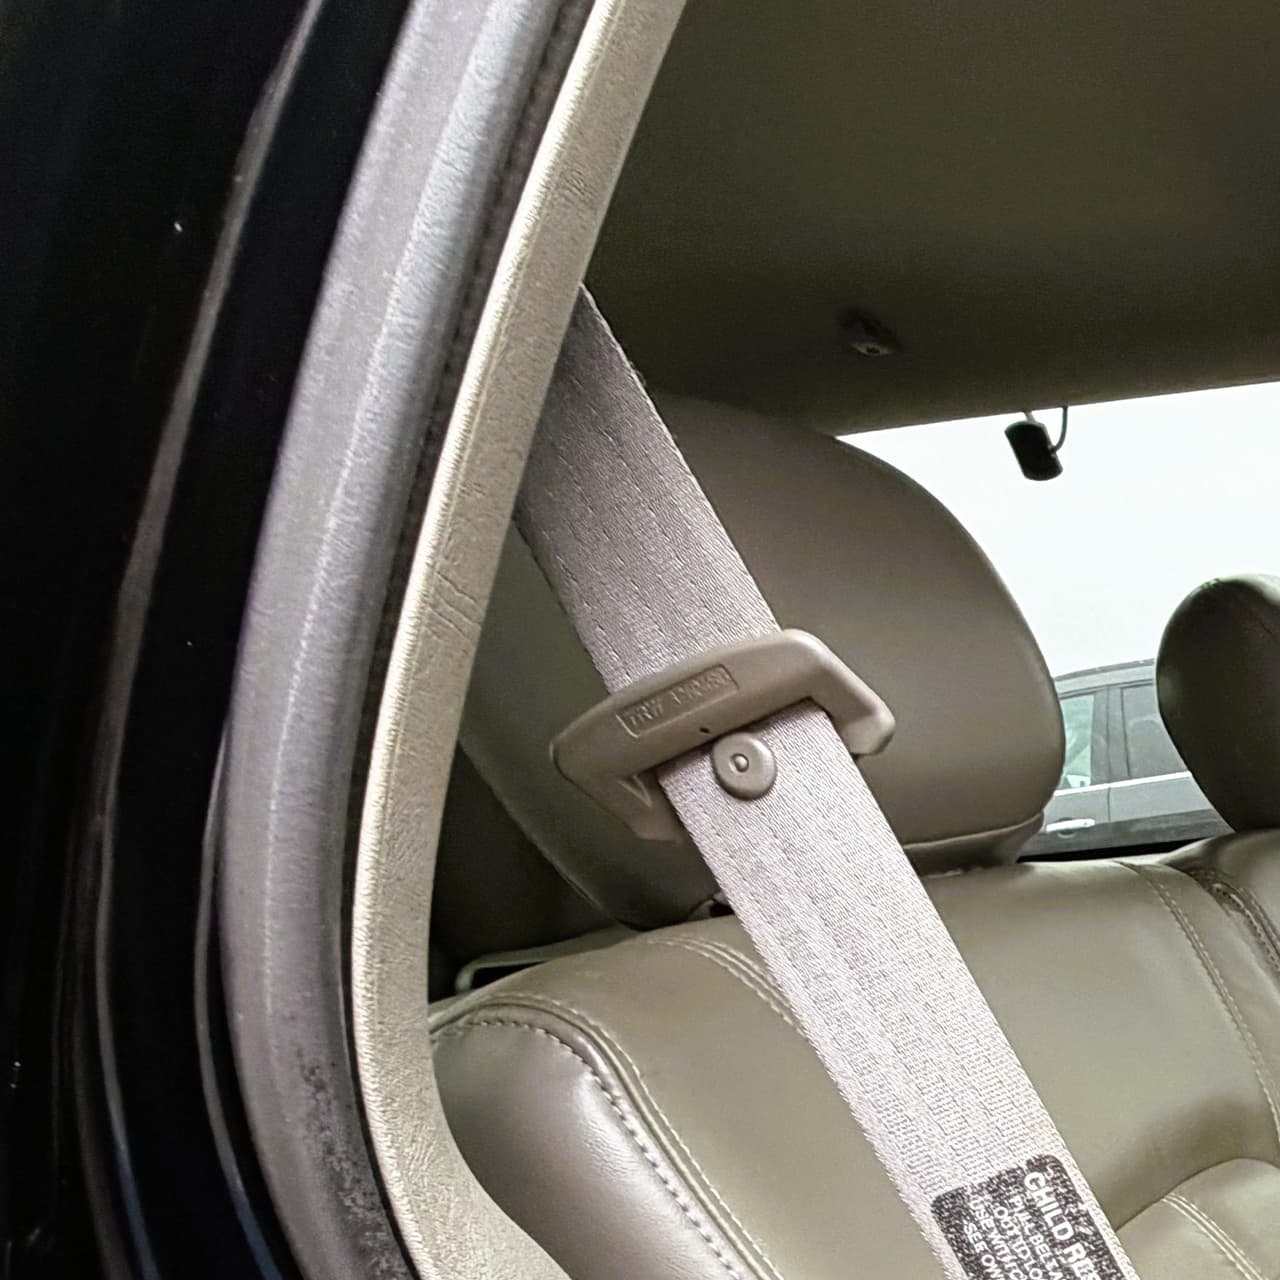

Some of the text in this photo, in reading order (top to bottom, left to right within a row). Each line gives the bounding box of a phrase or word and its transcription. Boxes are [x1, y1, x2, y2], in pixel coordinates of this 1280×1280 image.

[968, 1199, 993, 1230] USE
[994, 1206, 1018, 1237] OUT
[1010, 1238, 1032, 1260] TO
[1009, 1196, 1033, 1234] PULL
[1032, 1232, 1057, 1268] BELT
[1024, 1172, 1075, 1241] CHILD
